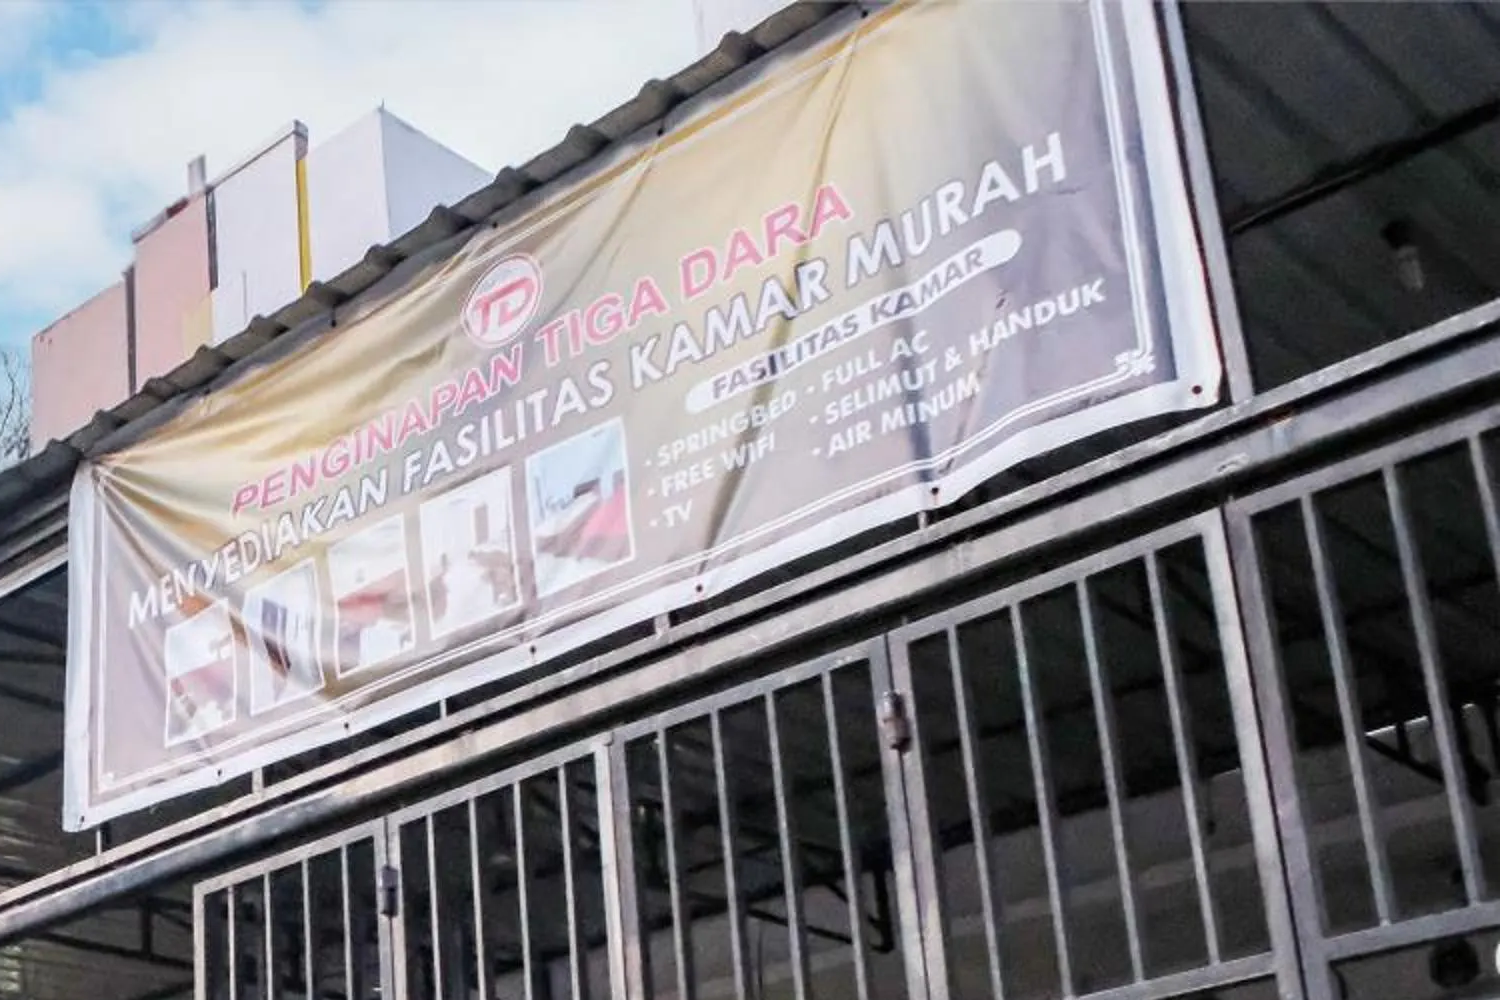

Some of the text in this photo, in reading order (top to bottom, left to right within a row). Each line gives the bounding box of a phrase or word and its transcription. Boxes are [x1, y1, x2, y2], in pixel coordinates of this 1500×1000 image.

[232, 181, 853, 517] PENGINAPAN TIGA DARA
[712, 247, 983, 399] FASILITAS KAMAR
[820, 331, 933, 392] FULL AC
[824, 278, 1107, 424] SELIMUT & HANDUK
[128, 132, 1068, 629] MENYEDIAKAN FASILITAS KAMAR MURAH
[827, 371, 982, 459] AIR MINUM
[657, 390, 797, 467] SPRINGBED
[660, 457, 715, 498] FREE
[662, 499, 694, 531] TV
